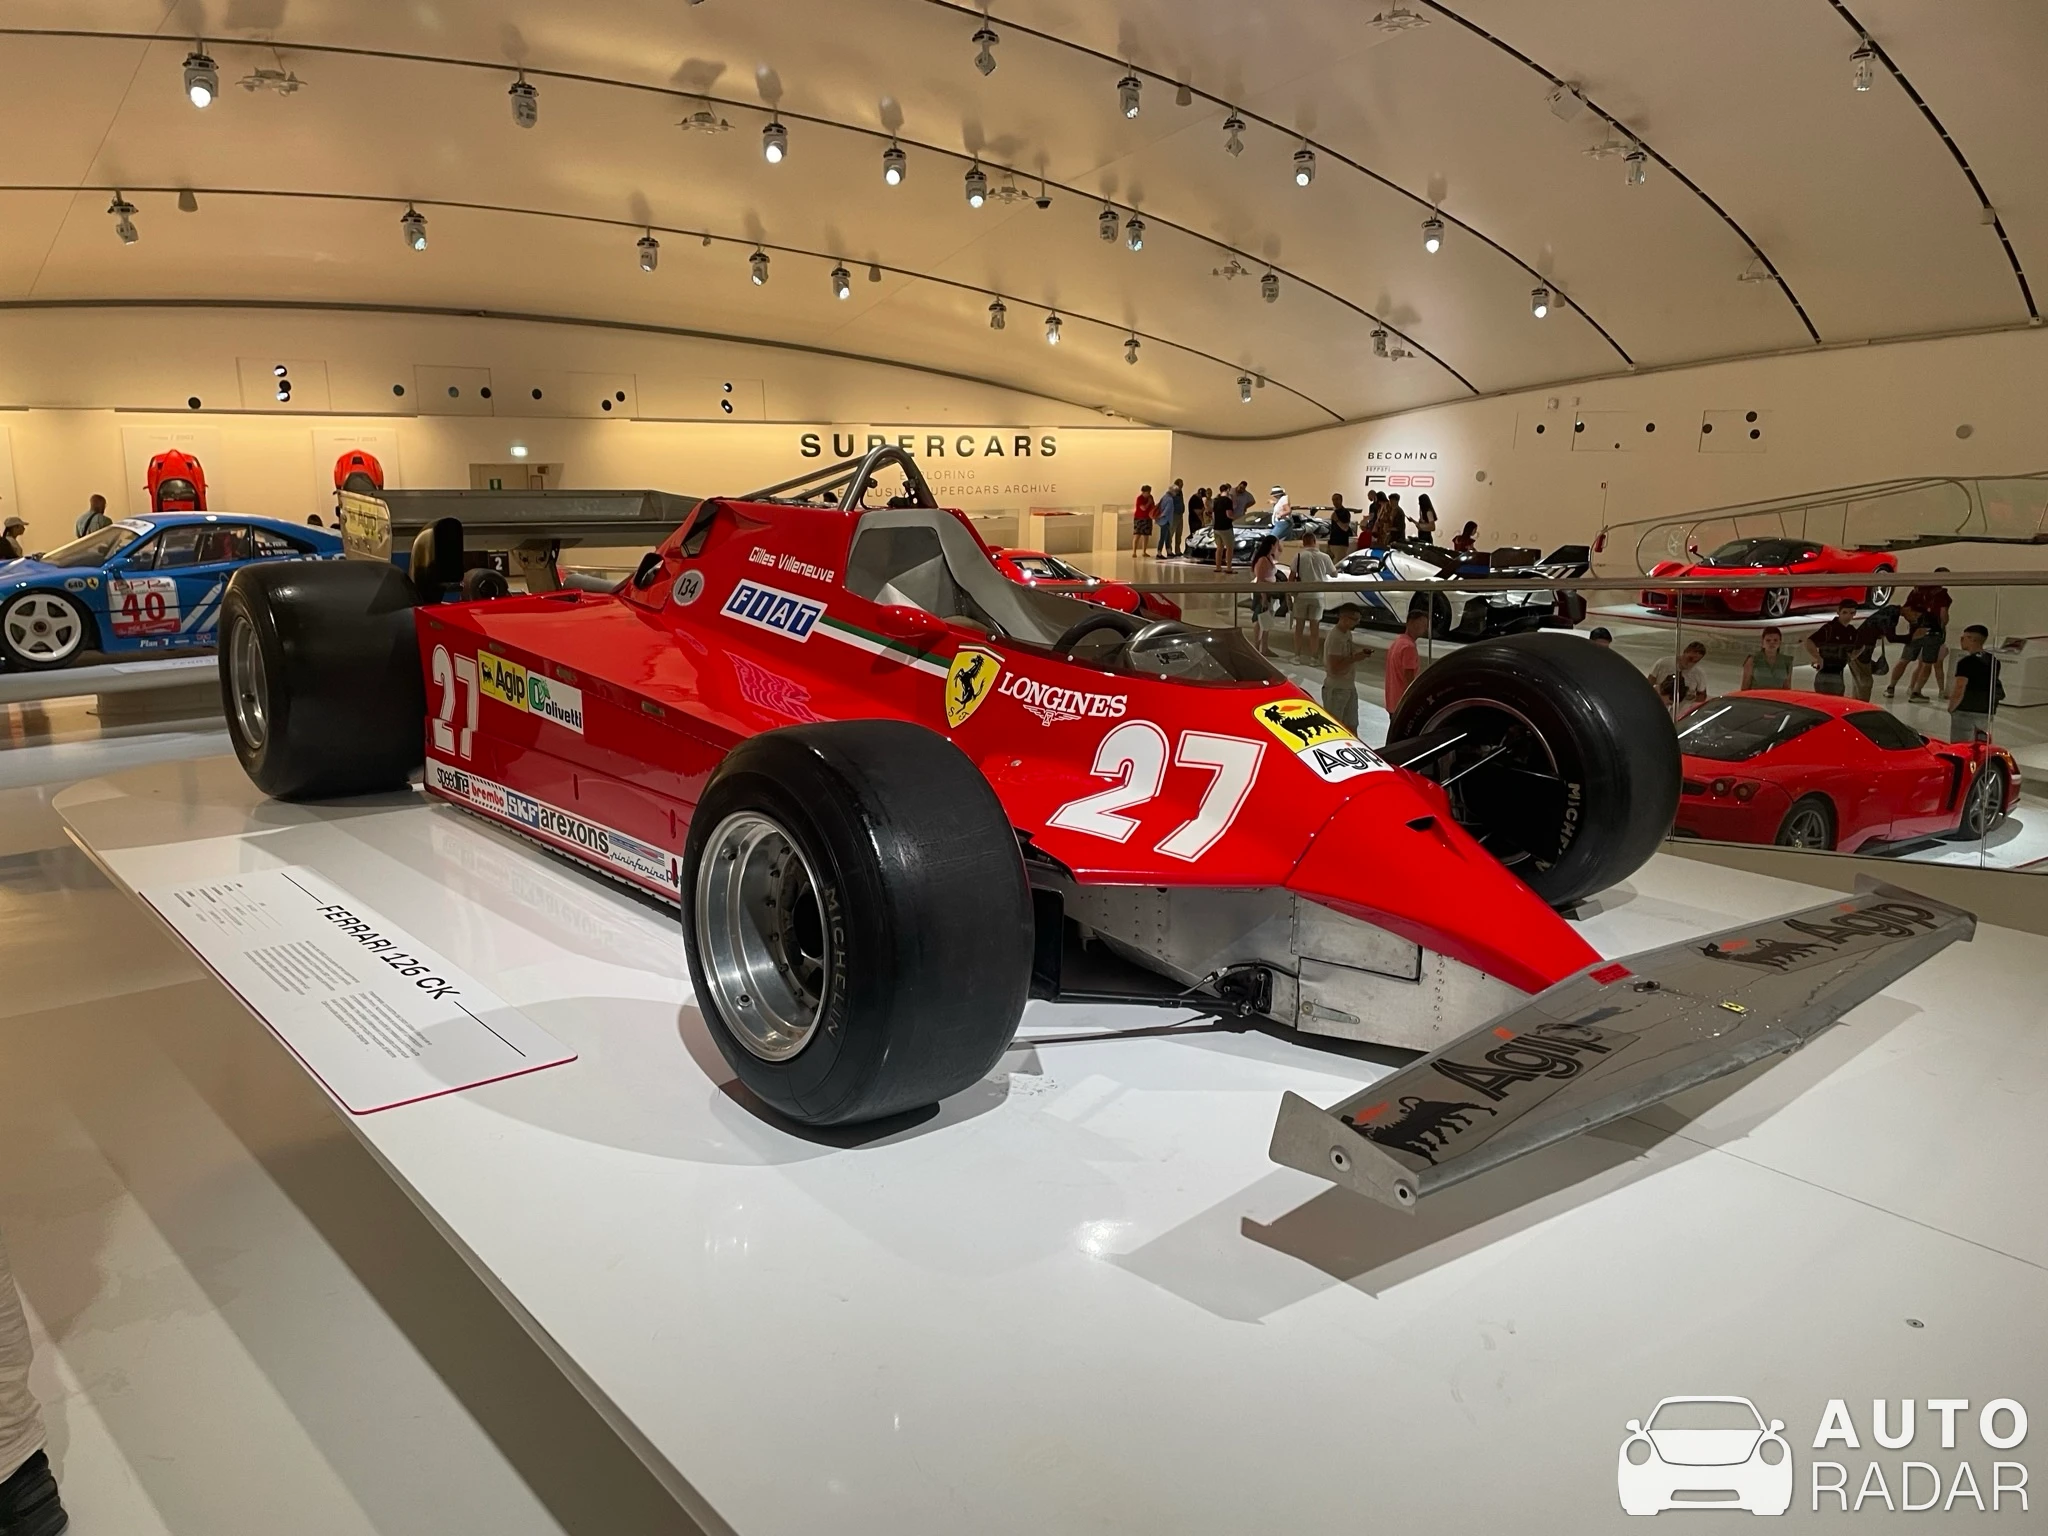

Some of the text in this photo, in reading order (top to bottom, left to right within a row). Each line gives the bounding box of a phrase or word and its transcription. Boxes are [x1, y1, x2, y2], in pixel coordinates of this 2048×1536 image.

[800, 433, 1057, 458] SUPERCARS
[1368, 452, 1438, 460] BECOMING
[900, 470, 975, 481] ELORING
[1004, 483, 1057, 494] ARCHIVE
[1365, 475, 1435, 488] F80
[494, 556, 503, 571] 2
[749, 546, 835, 583] Gilles Villeneuve
[678, 577, 700, 598] 134
[122, 591, 166, 622] 40
[731, 588, 818, 631] FIAT
[495, 660, 526, 704] Agip
[997, 671, 1128, 718] LONGINES
[432, 643, 480, 762] 27
[545, 700, 583, 729] olivetti
[1311, 742, 1387, 776] Agip
[471, 782, 505, 808] brembo
[1045, 719, 1269, 863] 27
[507, 795, 539, 823] SKF
[541, 806, 610, 855] arexons
[610, 851, 667, 882] pininfarina
[1783, 902, 1940, 945] Agip
[316, 905, 398, 953] FERRARI
[380, 952, 431, 976] 126
[415, 977, 461, 1000] CK
[824, 885, 848, 1039] MICHELIN
[1430, 1022, 1613, 1102] Agip
